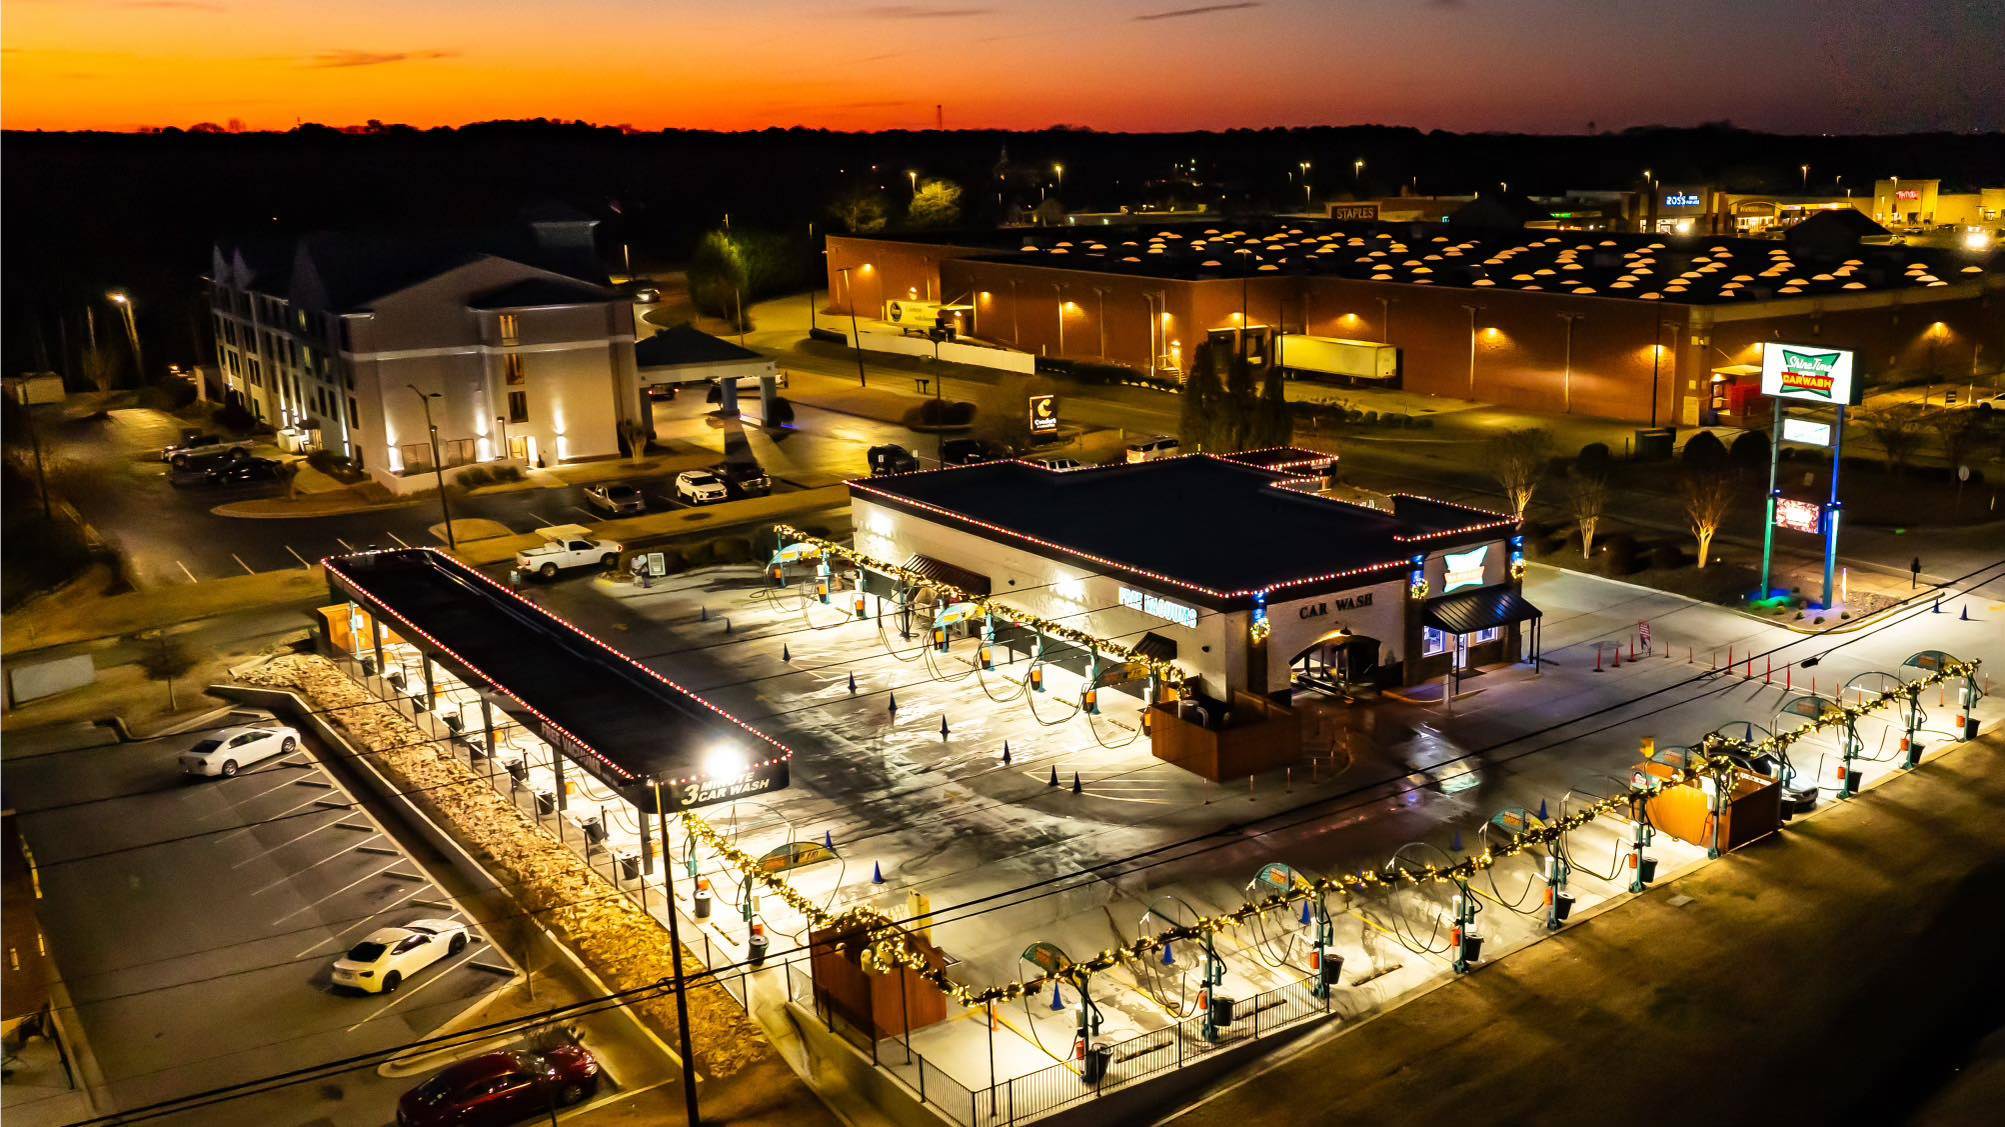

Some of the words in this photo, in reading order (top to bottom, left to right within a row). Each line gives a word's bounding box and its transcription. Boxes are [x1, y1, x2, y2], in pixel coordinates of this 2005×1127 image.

[1666, 195, 1686, 205] ROSS
[1336, 207, 1375, 220] STAPLES
[1787, 356, 1812, 370] Shine
[1299, 602, 1328, 619] CAR
[1335, 592, 1374, 612] WASH
[681, 784, 700, 805] 3
[698, 787, 727, 802] CAR
[729, 778, 770, 796] WASH
